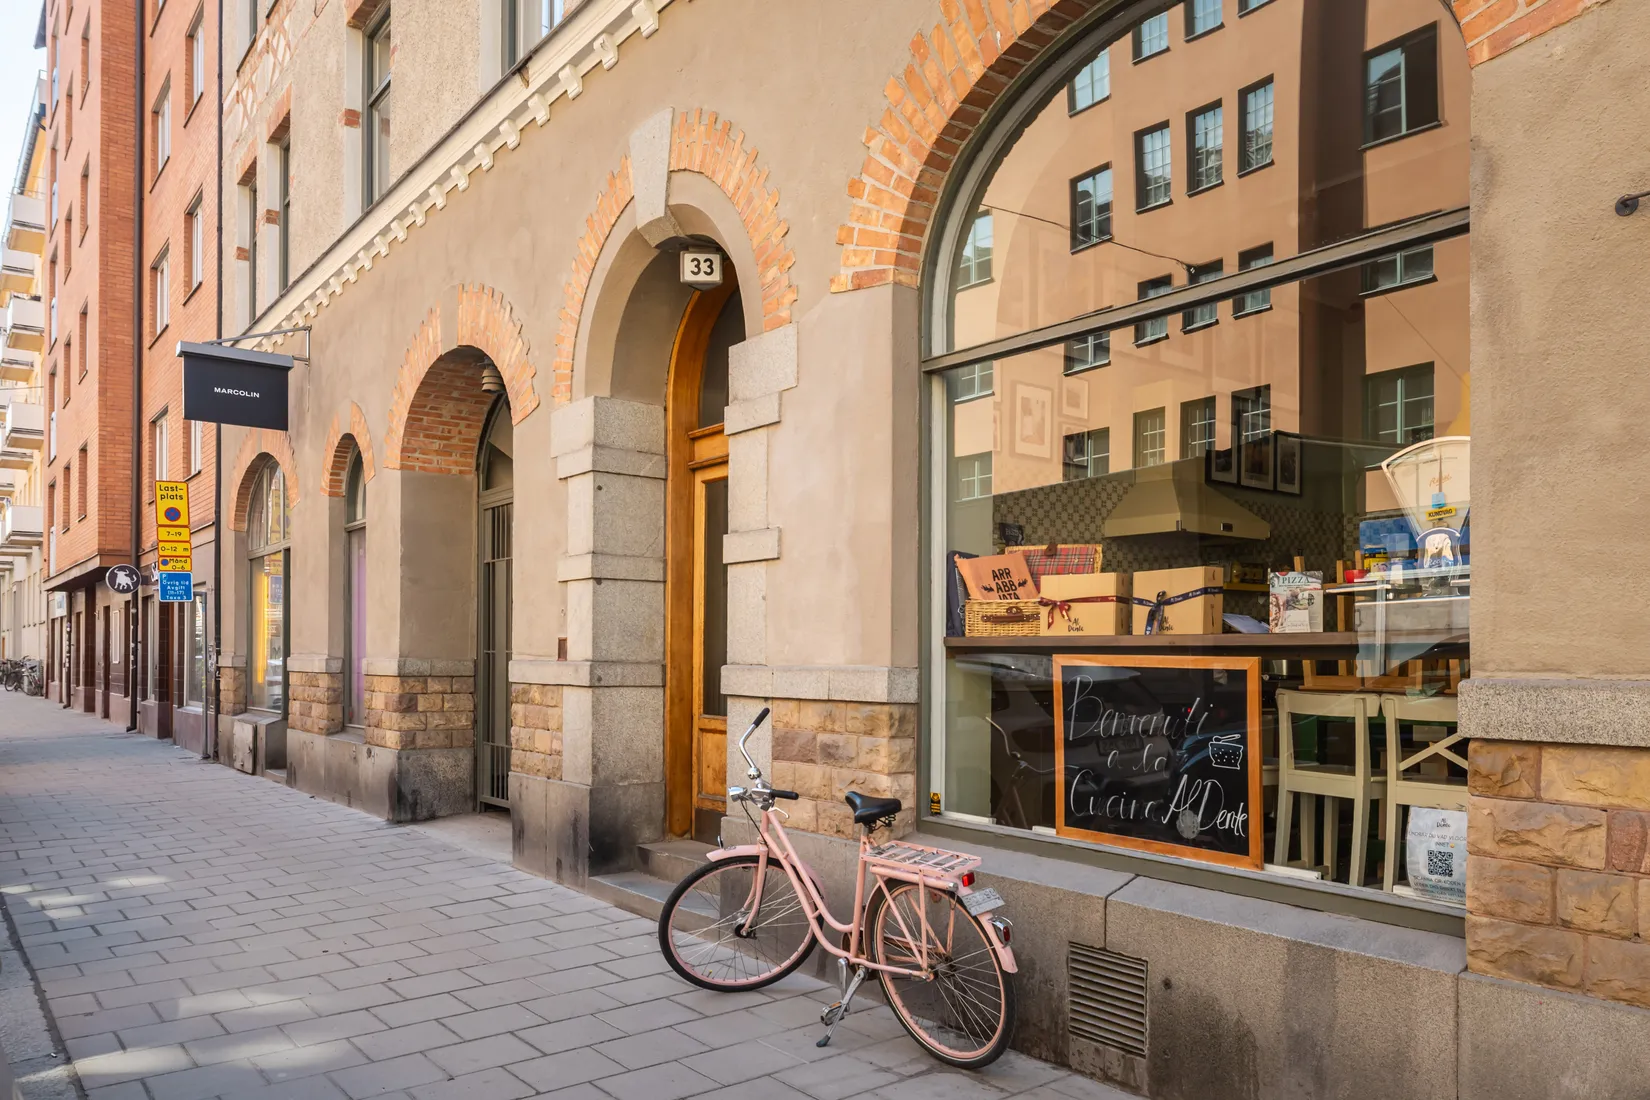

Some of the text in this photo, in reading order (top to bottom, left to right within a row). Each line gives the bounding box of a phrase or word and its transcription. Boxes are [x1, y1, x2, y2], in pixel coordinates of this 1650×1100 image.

[690, 257, 715, 277] 33
[213, 386, 260, 399] MARCOLIN
[159, 484, 184, 492] Last-
[160, 492, 184, 501] plats
[991, 567, 1013, 582] ARR
[1282, 575, 1312, 585] PIZZA
[995, 579, 1019, 594] ABB
[1067, 624, 1084, 632] Dente
[1071, 617, 1080, 627] Al
[1067, 674, 1214, 742] Benvenuti
[1107, 749, 1123, 770] a
[1132, 743, 1170, 779] la
[1070, 769, 1248, 838] Cucina Al Dente
